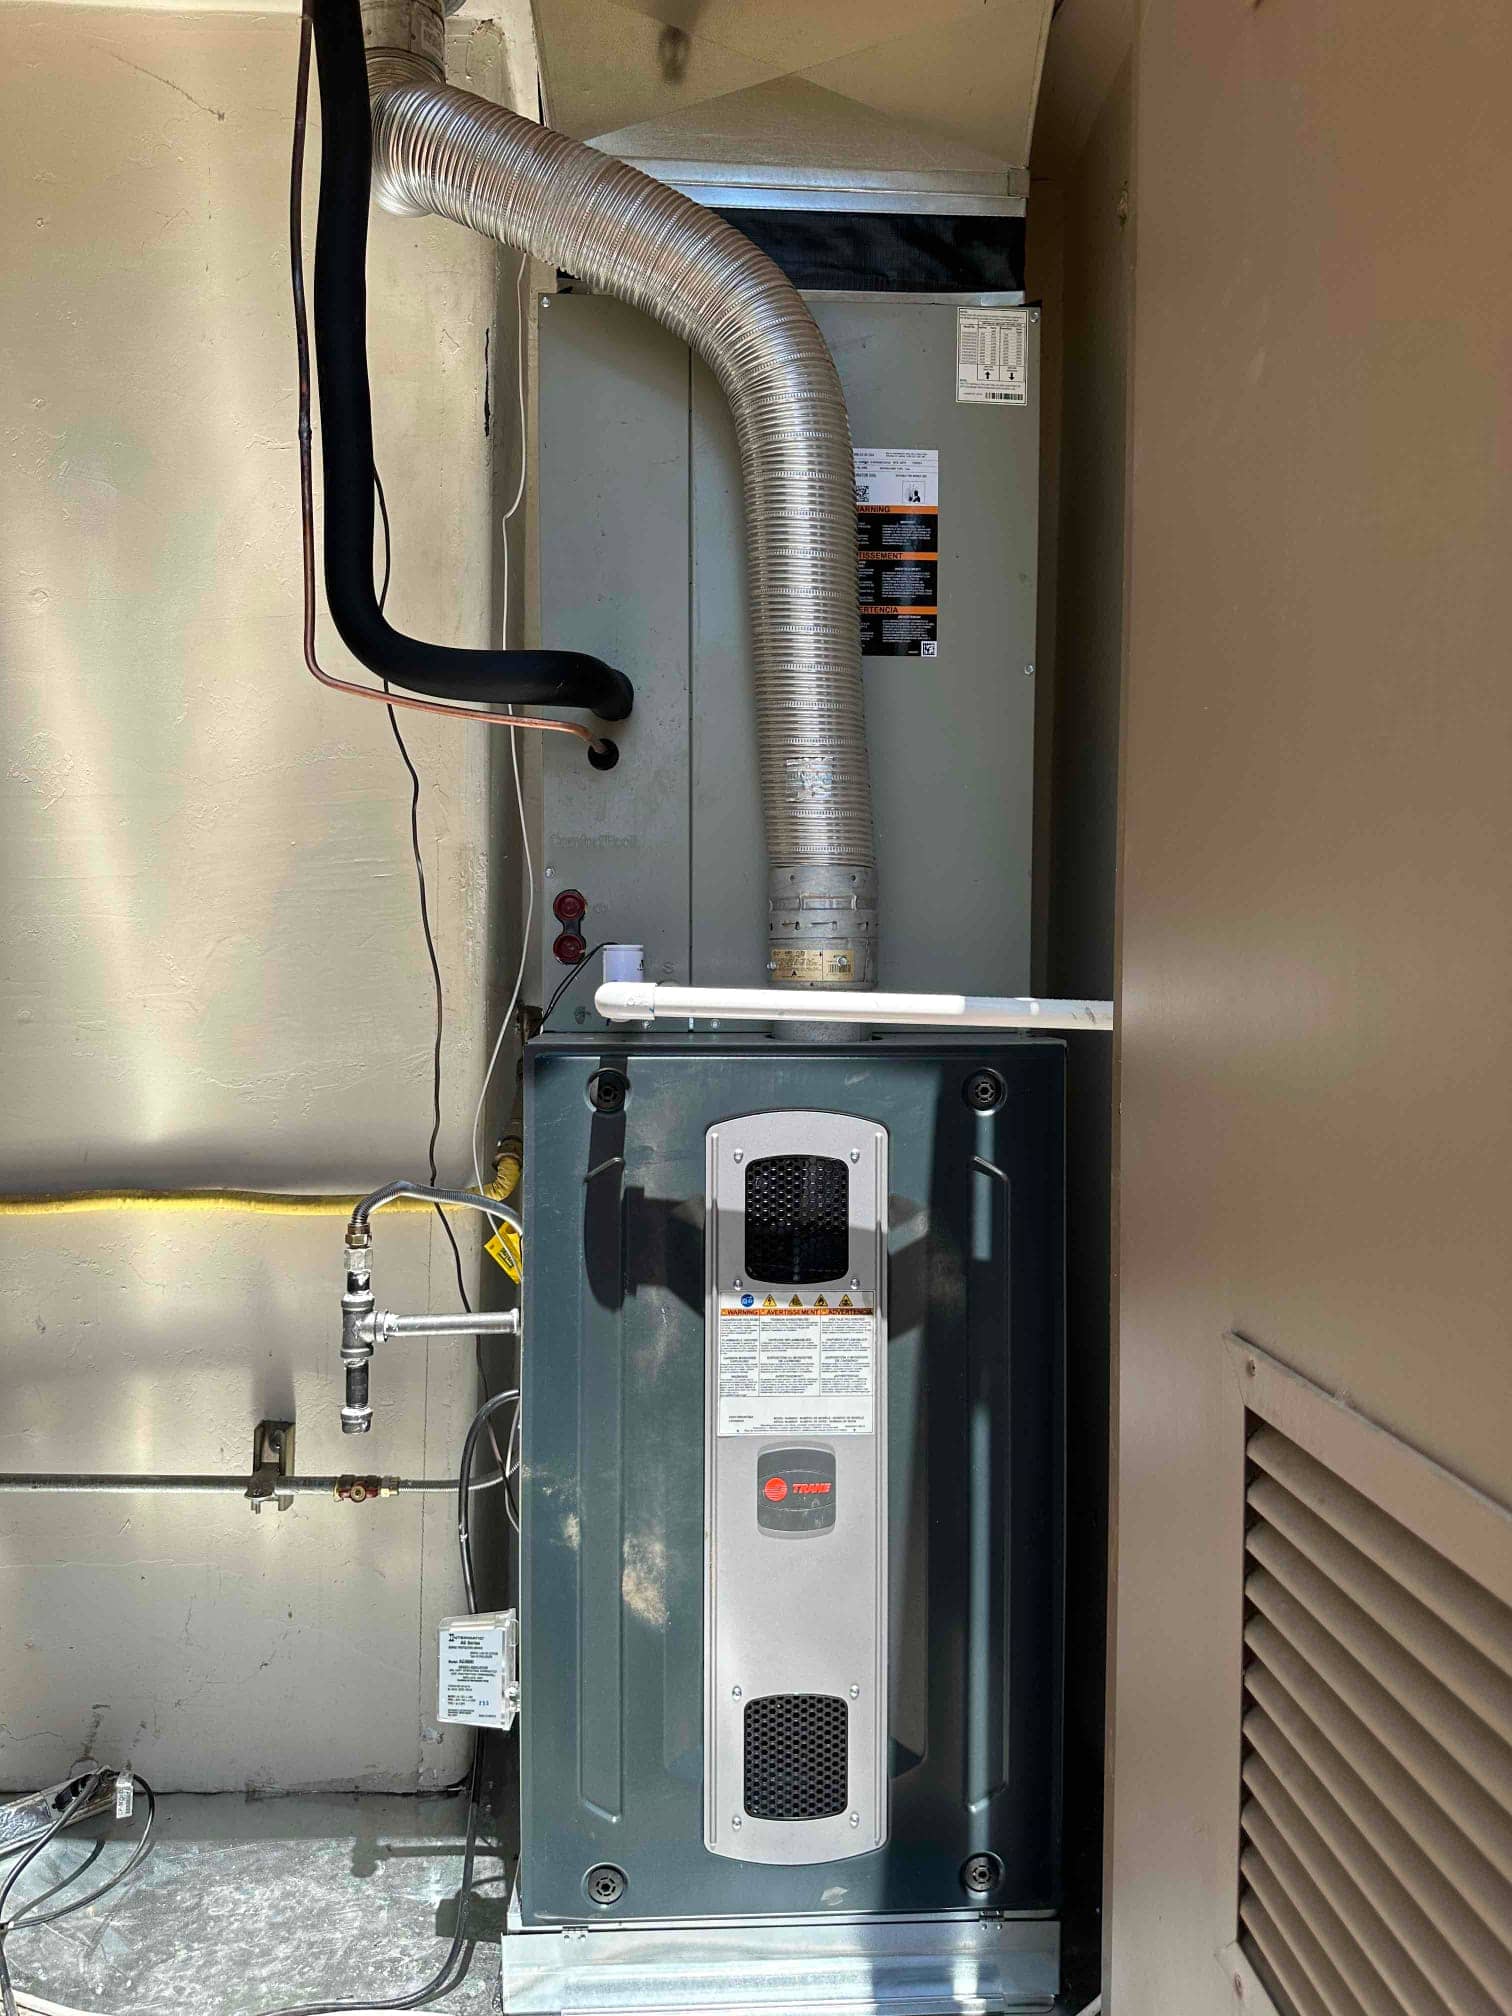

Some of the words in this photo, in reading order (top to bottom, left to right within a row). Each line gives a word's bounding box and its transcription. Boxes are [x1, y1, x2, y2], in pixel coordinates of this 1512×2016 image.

[857, 504, 890, 513] ARNING
[859, 606, 899, 614] ERTENCIA
[727, 1308, 758, 1316] WARNING
[766, 1308, 818, 1316] AVERTISSEMENT
[792, 1482, 832, 1494] TRANE
